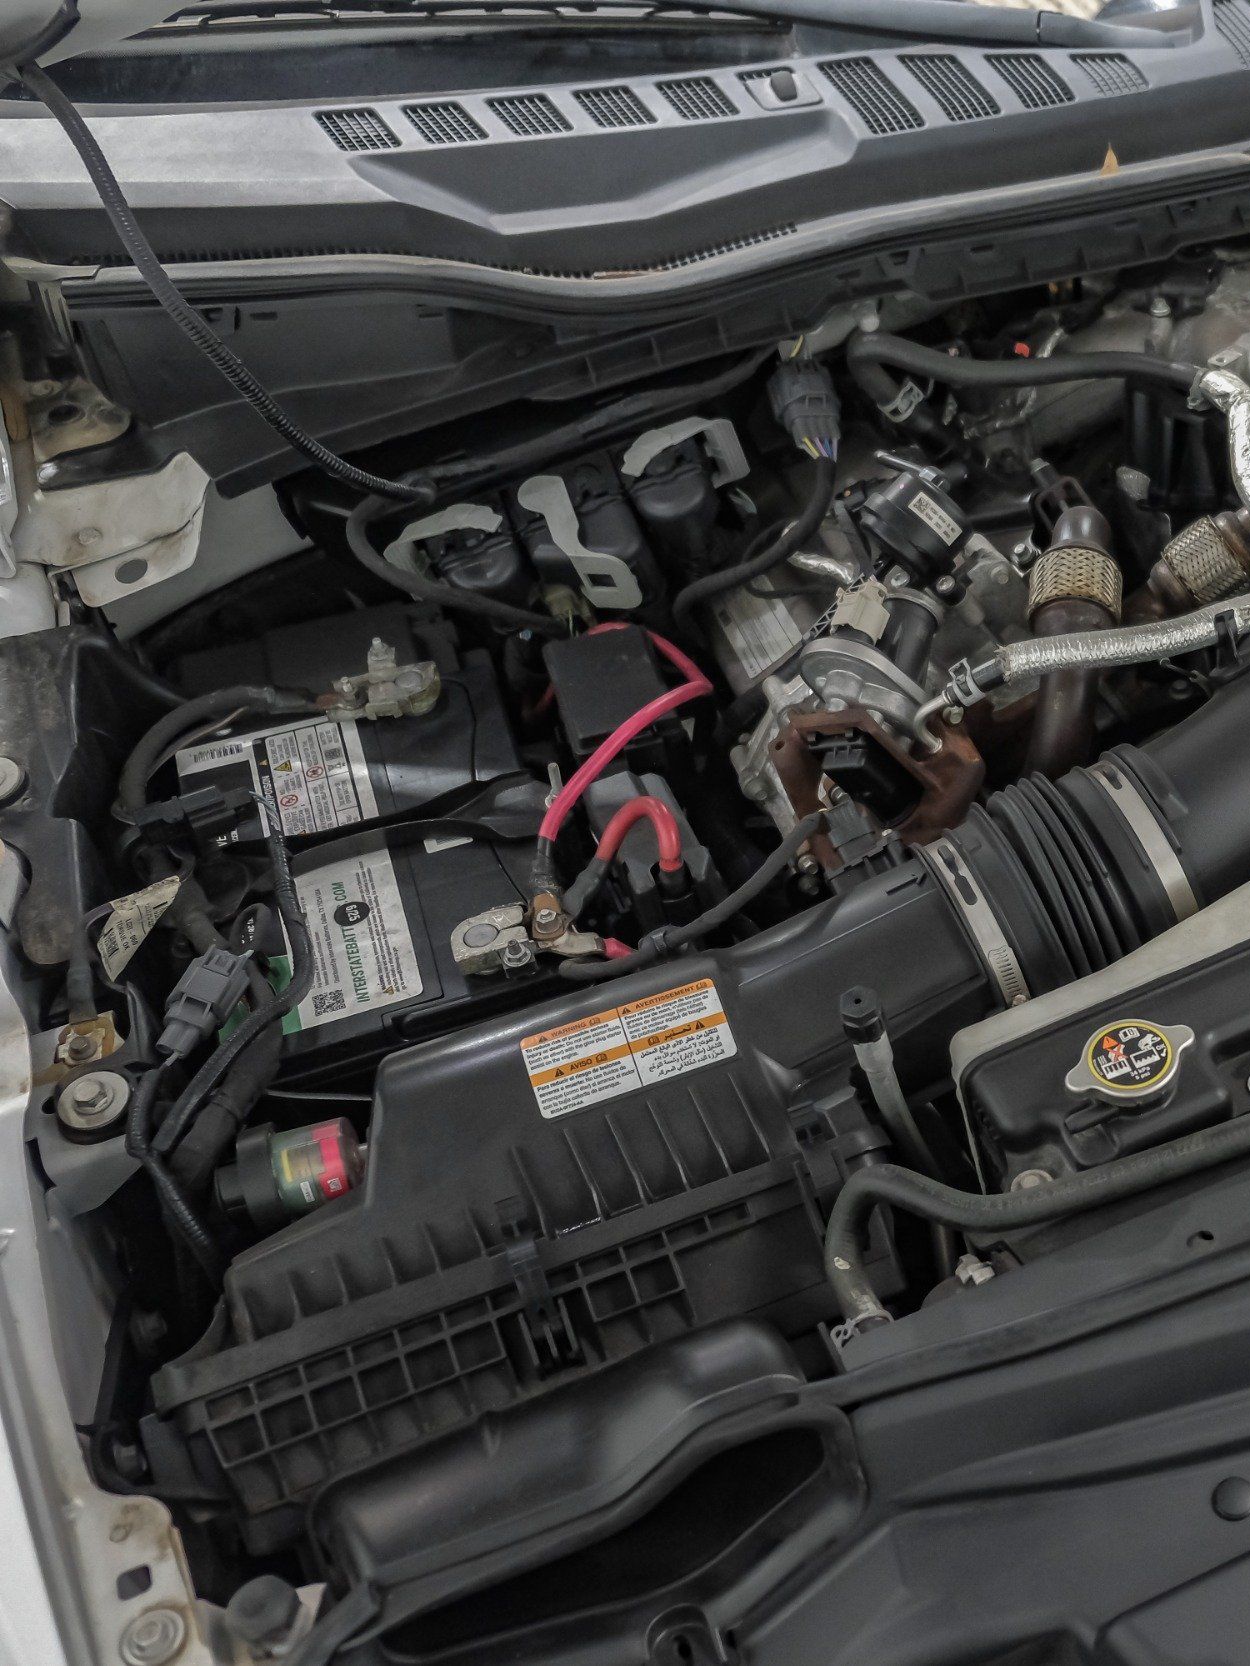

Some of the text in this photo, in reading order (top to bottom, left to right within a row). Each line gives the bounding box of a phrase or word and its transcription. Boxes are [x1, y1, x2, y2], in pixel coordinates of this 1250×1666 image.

[634, 987, 695, 1007] AVERTISSEMENT
[551, 1023, 587, 1036] WARNING
[1155, 1043, 1166, 1051] OK
[569, 1059, 593, 1069] AVISO
